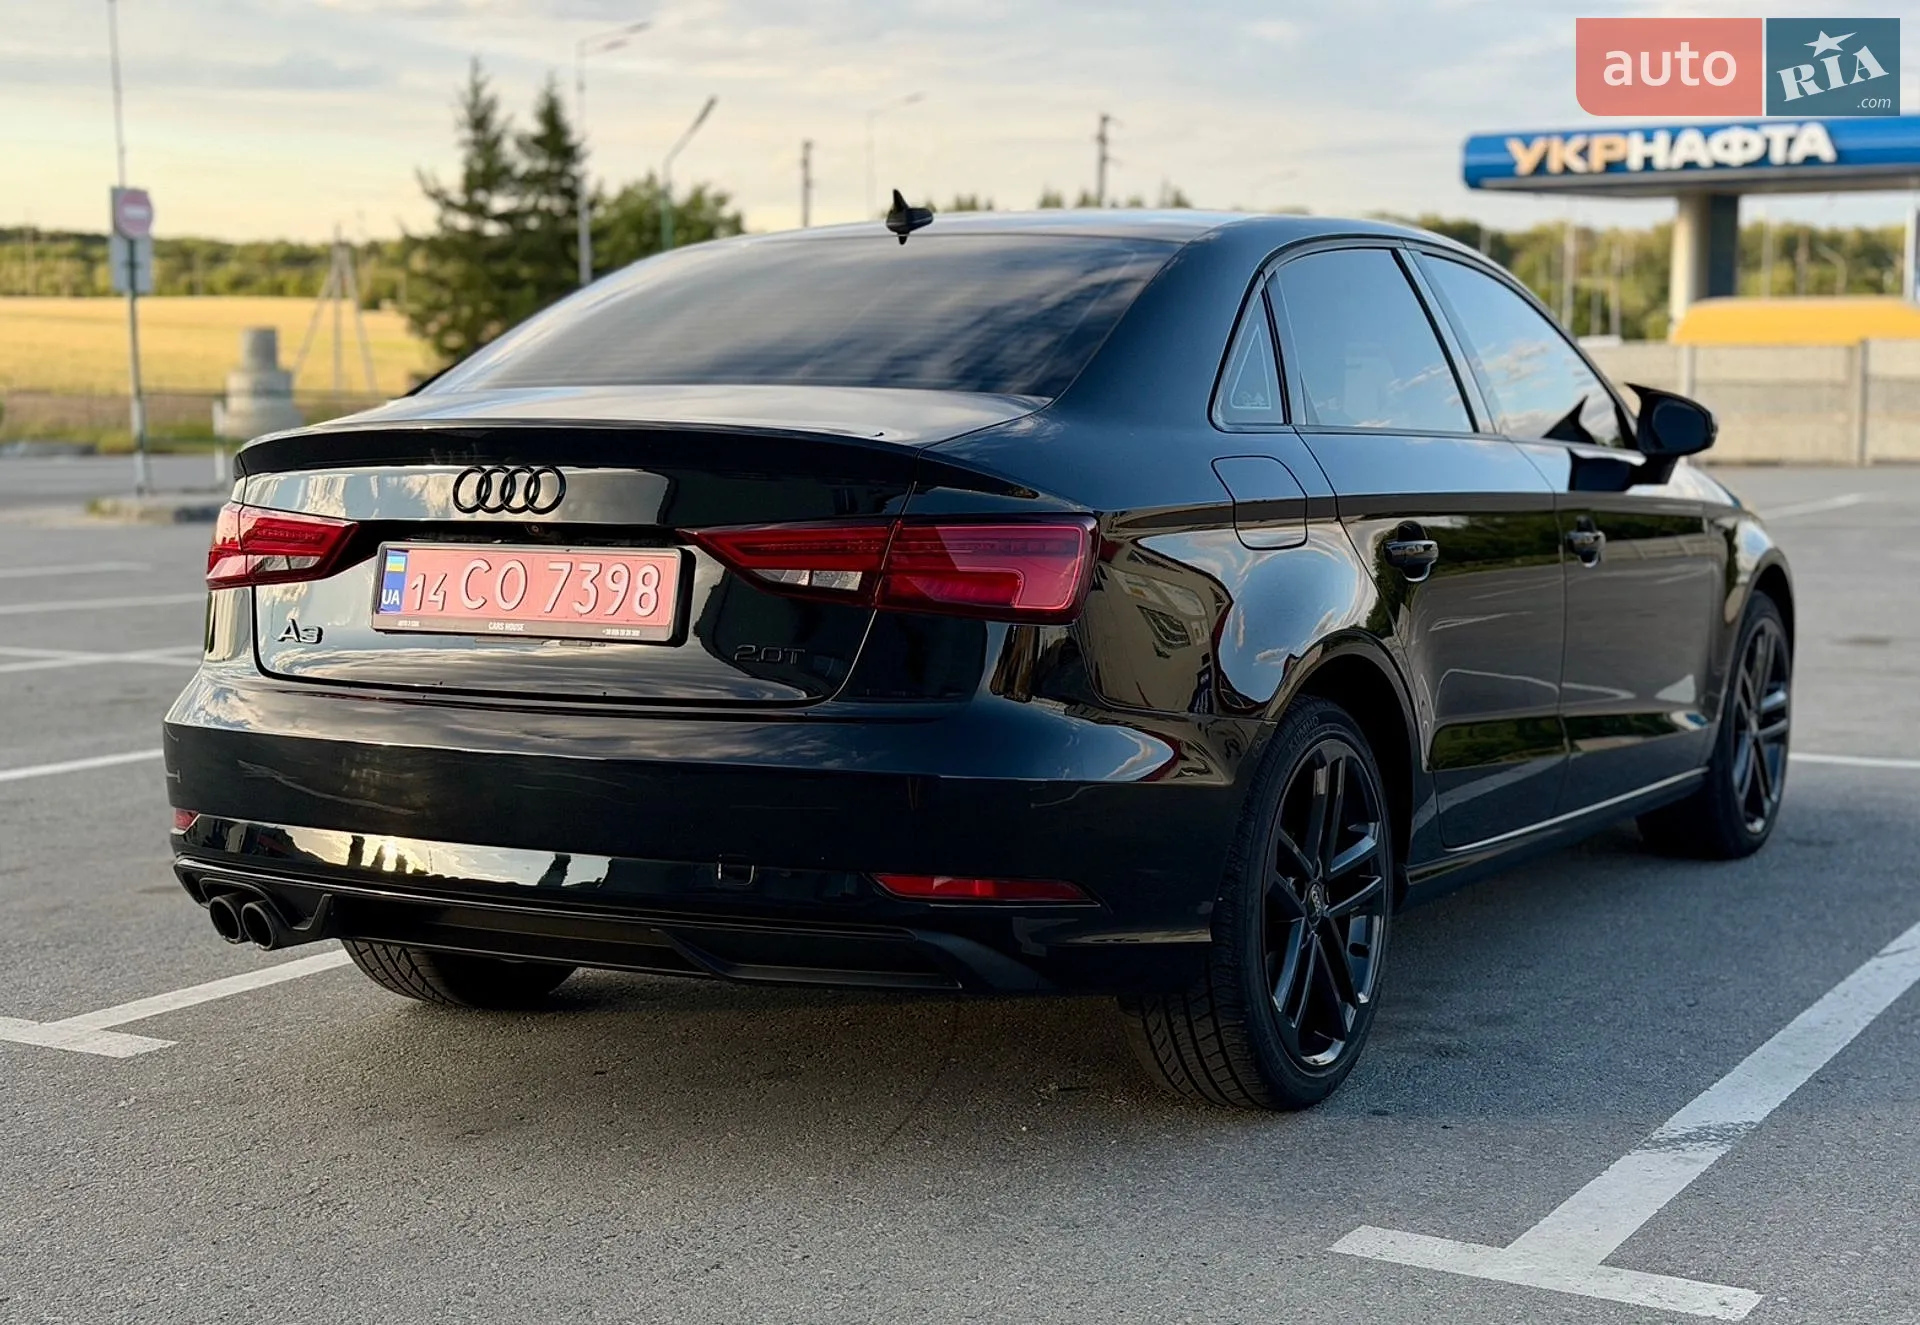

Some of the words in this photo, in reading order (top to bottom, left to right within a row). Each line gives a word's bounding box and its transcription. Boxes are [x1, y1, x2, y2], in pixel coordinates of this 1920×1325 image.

[1506, 122, 1837, 176] УКРНАФТА
[382, 588, 400, 606] UA
[410, 571, 448, 612] 14
[460, 558, 529, 612] CO
[544, 561, 663, 618] 7398
[277, 618, 324, 644] A3
[488, 621, 504, 631] CARS
[505, 622, 525, 632] HOUSE
